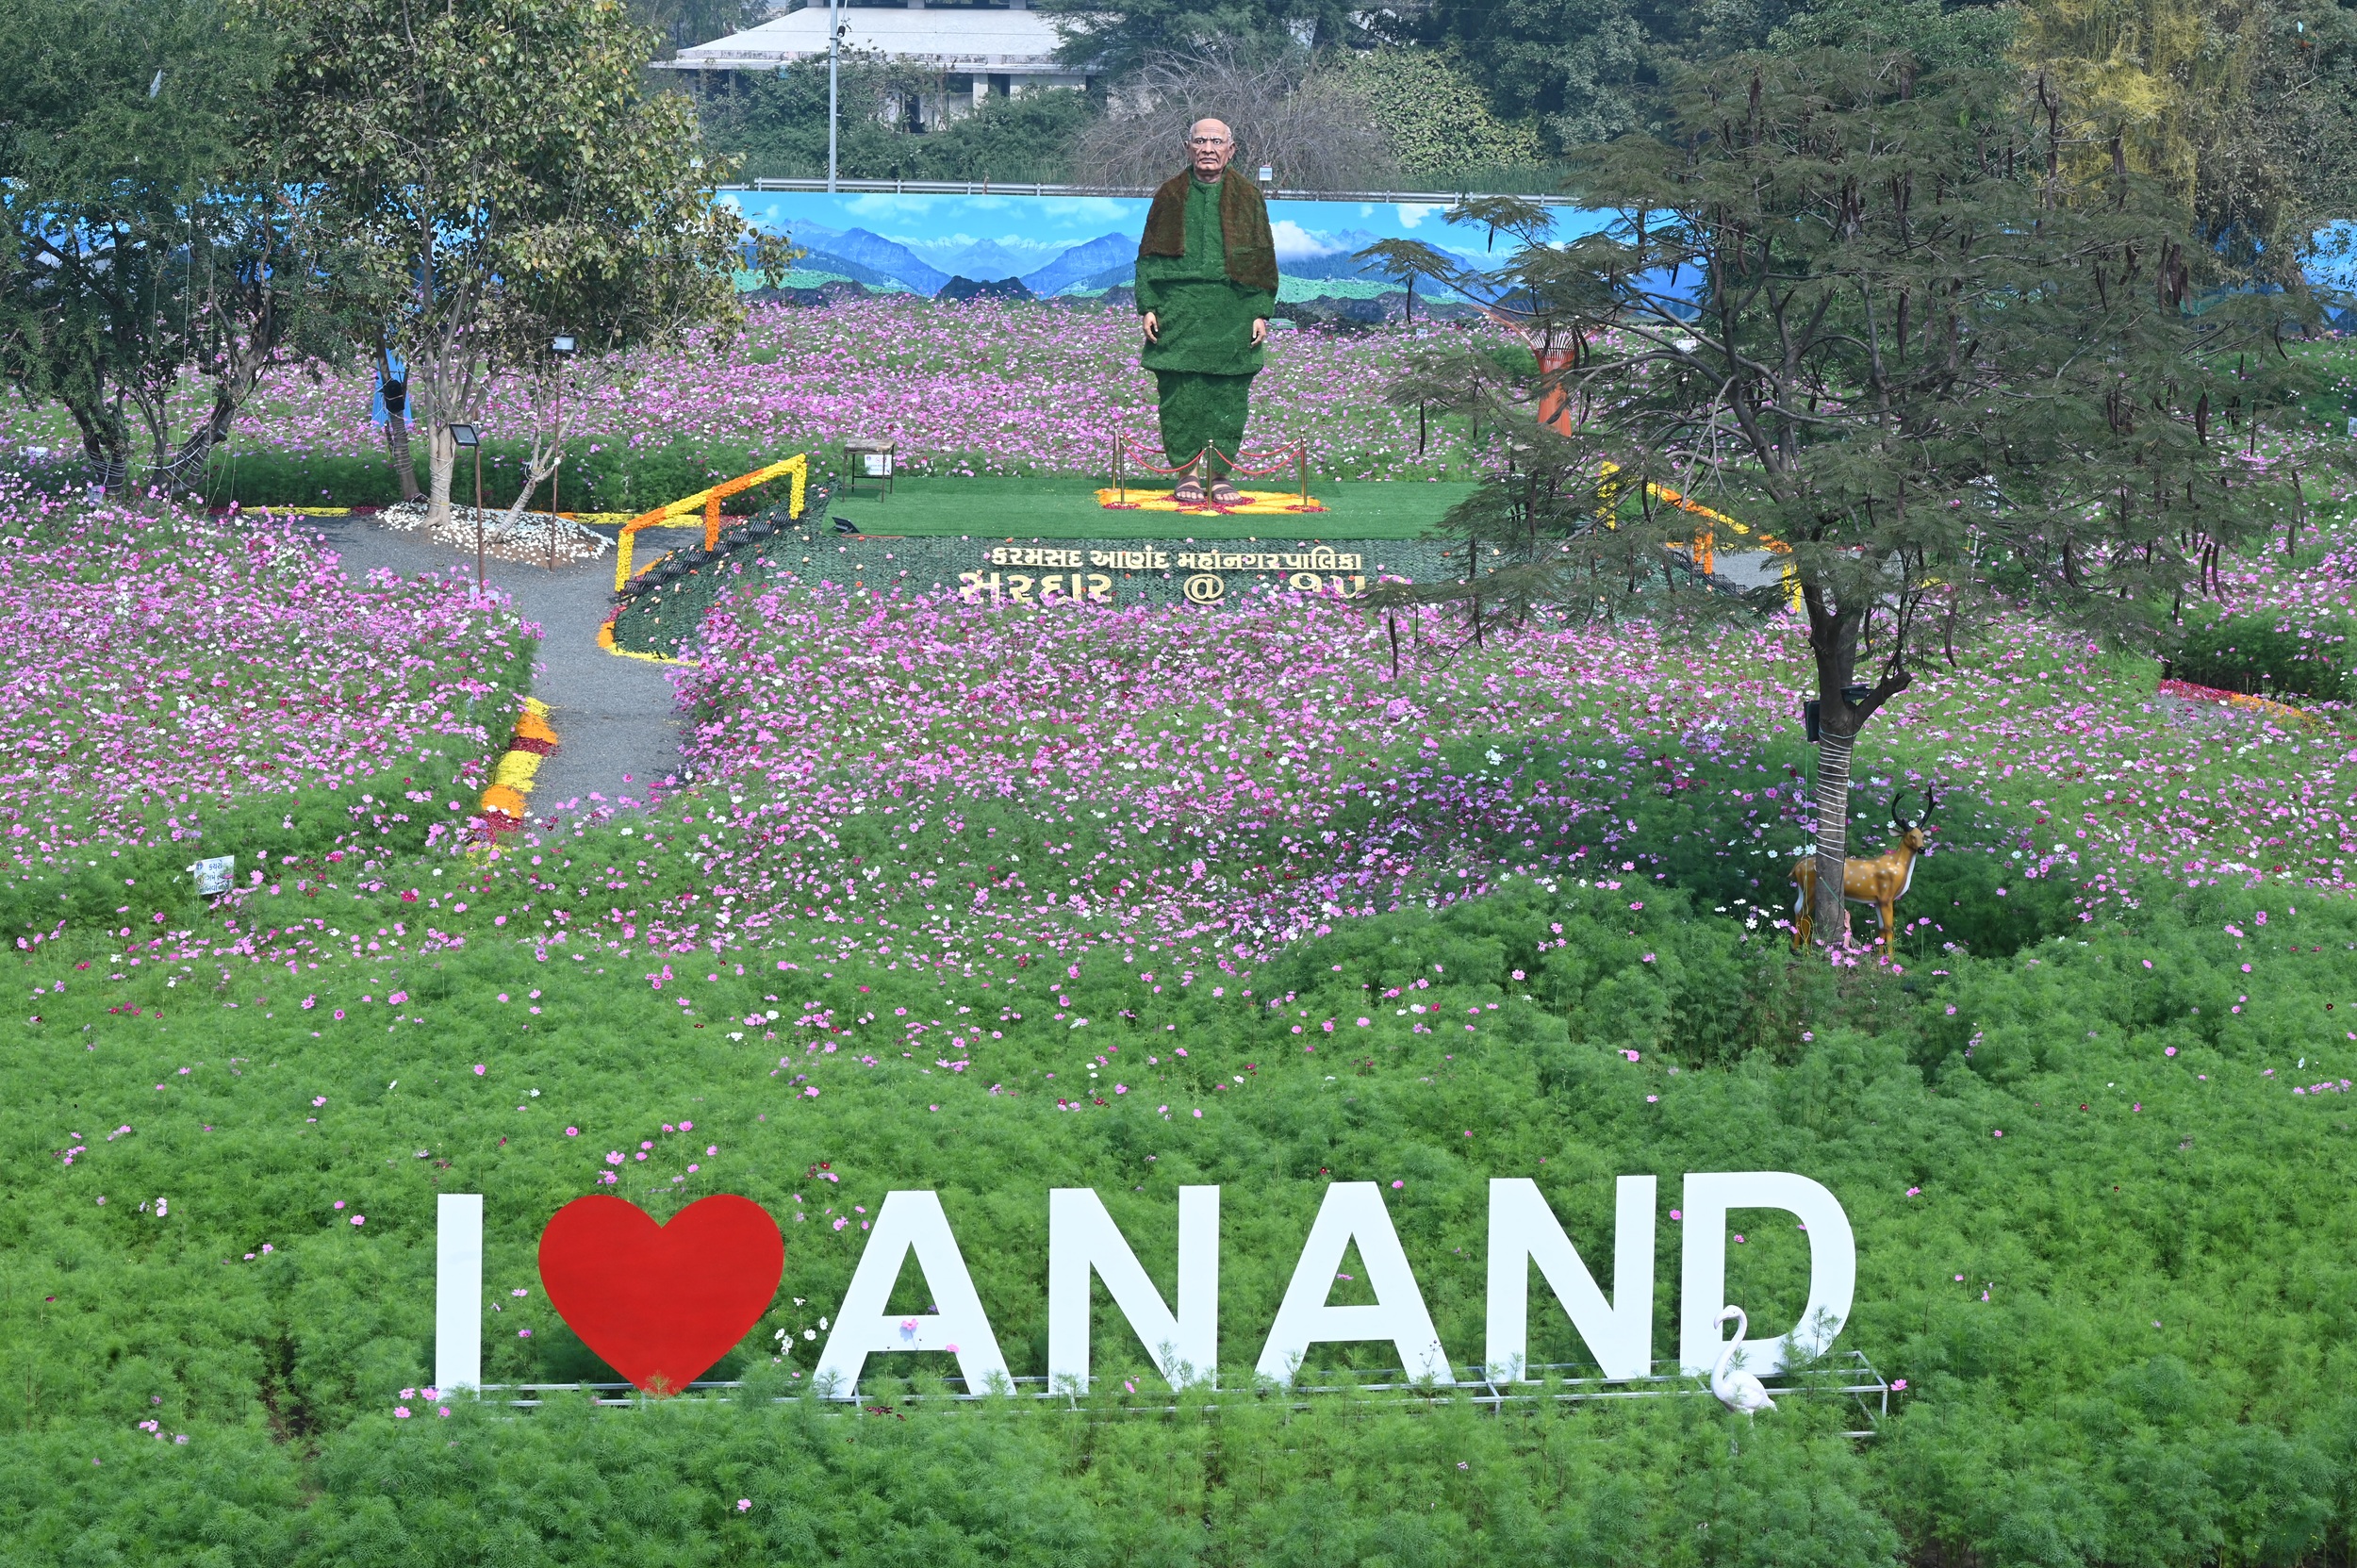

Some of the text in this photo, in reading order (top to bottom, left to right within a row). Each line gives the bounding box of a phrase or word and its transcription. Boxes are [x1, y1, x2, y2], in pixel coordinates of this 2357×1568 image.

[992, 547, 1083, 567] કરમસદ
[1090, 545, 1169, 569] આણંદ
[958, 571, 1412, 605] સરદાર @ ૧૫
[436, 1171, 1856, 1401] I ANAND
